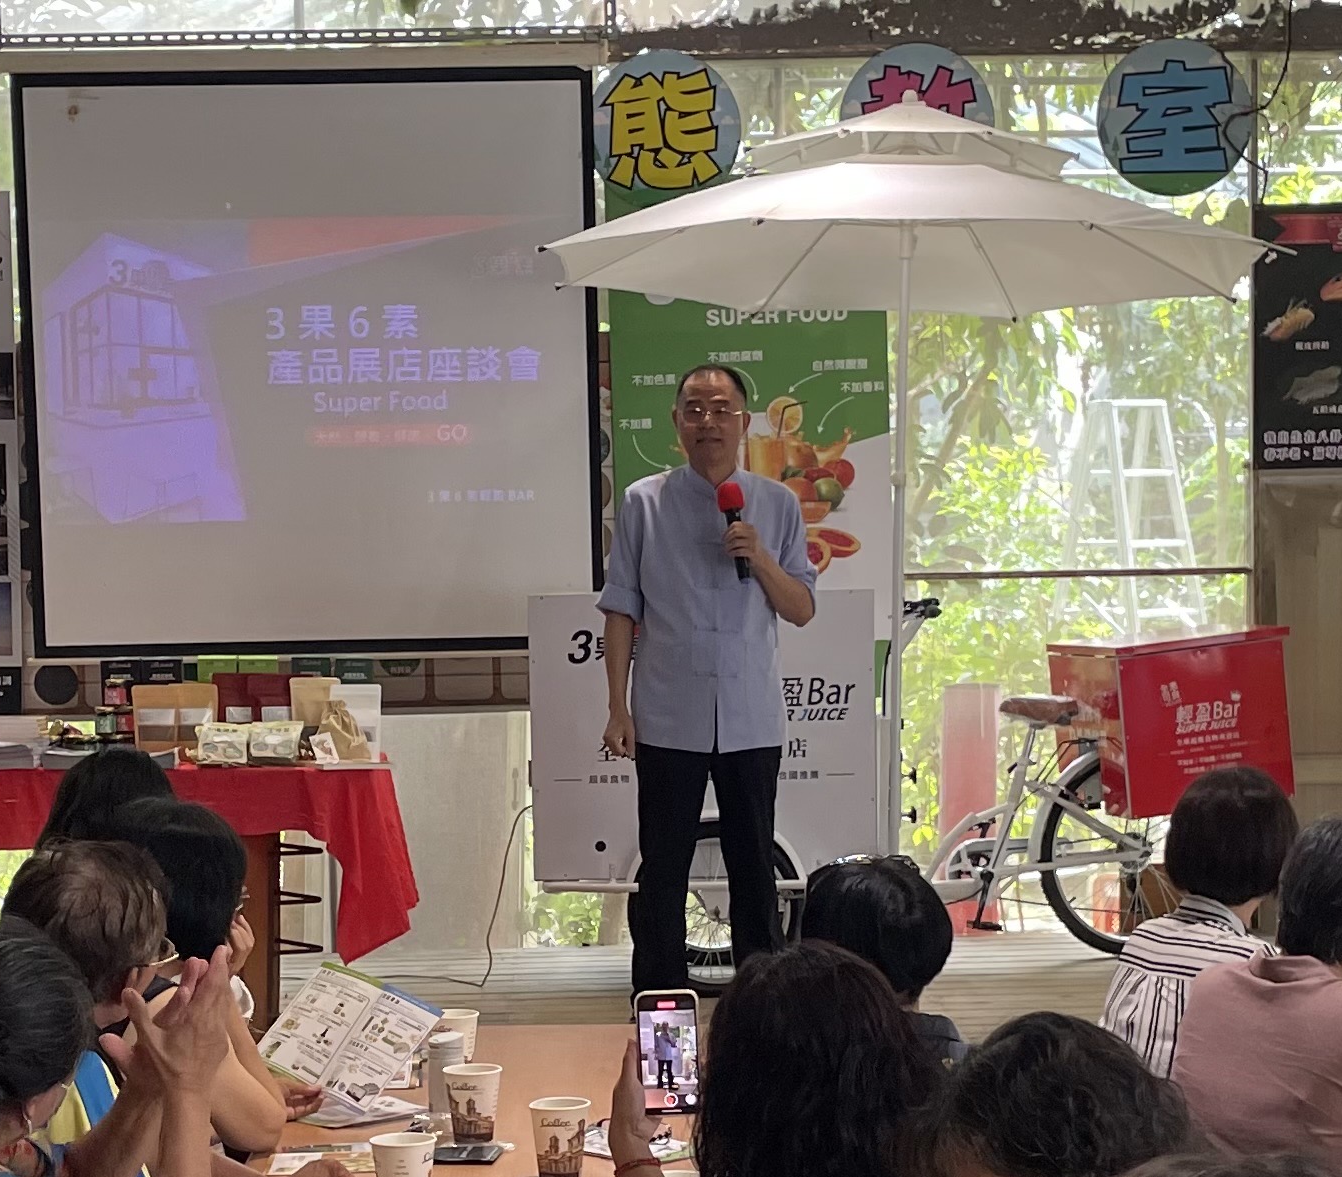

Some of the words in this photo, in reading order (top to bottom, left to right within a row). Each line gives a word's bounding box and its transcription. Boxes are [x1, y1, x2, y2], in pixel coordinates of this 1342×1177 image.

[601, 68, 721, 189] 熊
[1117, 58, 1233, 175] 室
[706, 309, 780, 326] SUPER
[787, 308, 849, 323] FOOD
[265, 346, 543, 386] 產品展店座談會
[313, 391, 382, 416] Super
[388, 390, 449, 412] Food
[798, 708, 849, 721] JUICE
